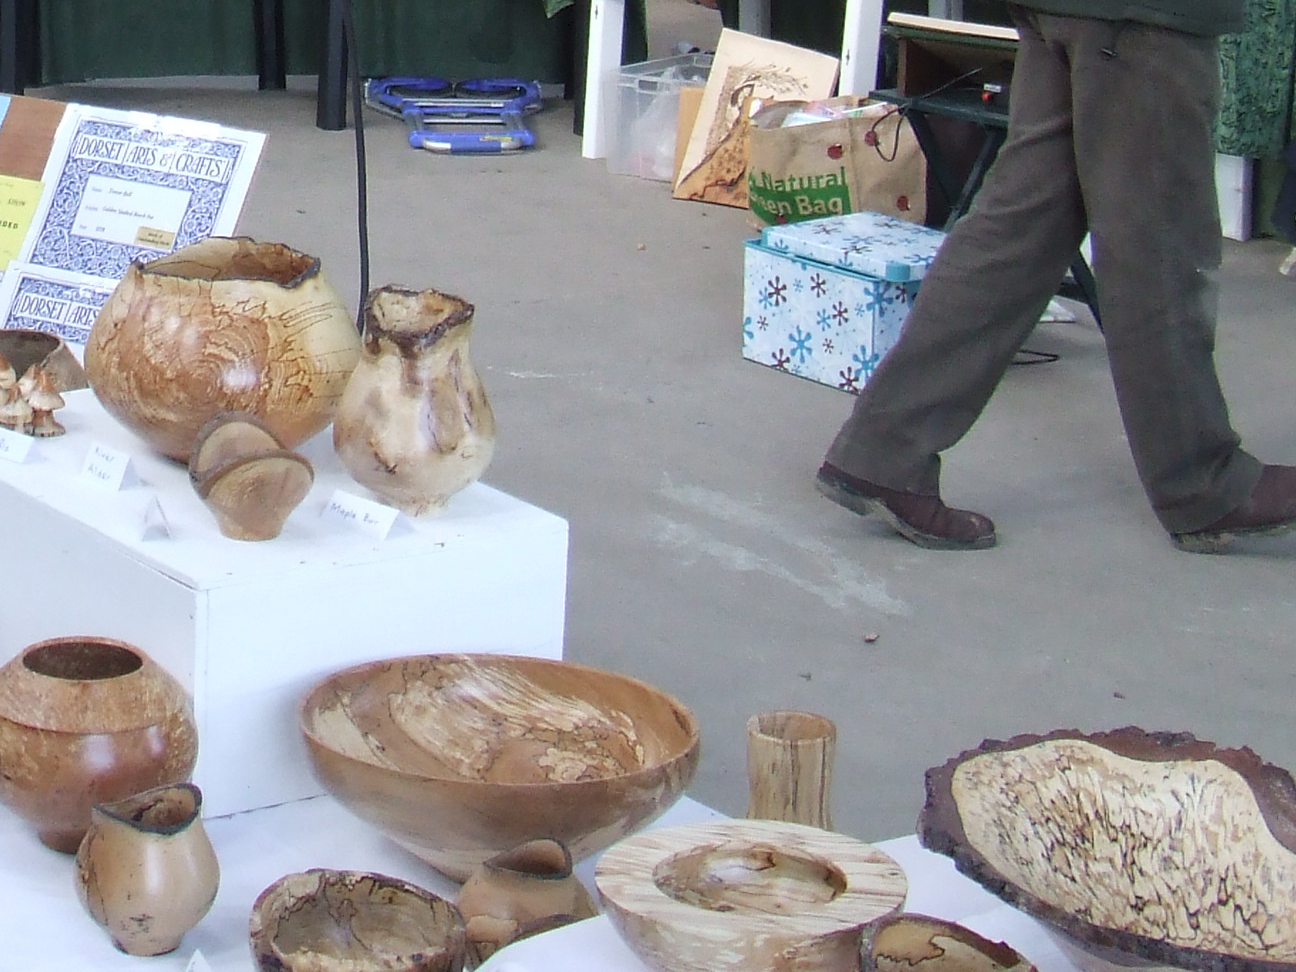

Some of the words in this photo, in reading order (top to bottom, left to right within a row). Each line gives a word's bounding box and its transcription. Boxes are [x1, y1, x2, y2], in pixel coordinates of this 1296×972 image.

[78, 136, 125, 160] DORSET
[125, 144, 158, 166] ARTS
[159, 153, 172, 167] &
[761, 166, 845, 190] Natural
[795, 195, 843, 216] Bag
[20, 295, 67, 320] DORSET
